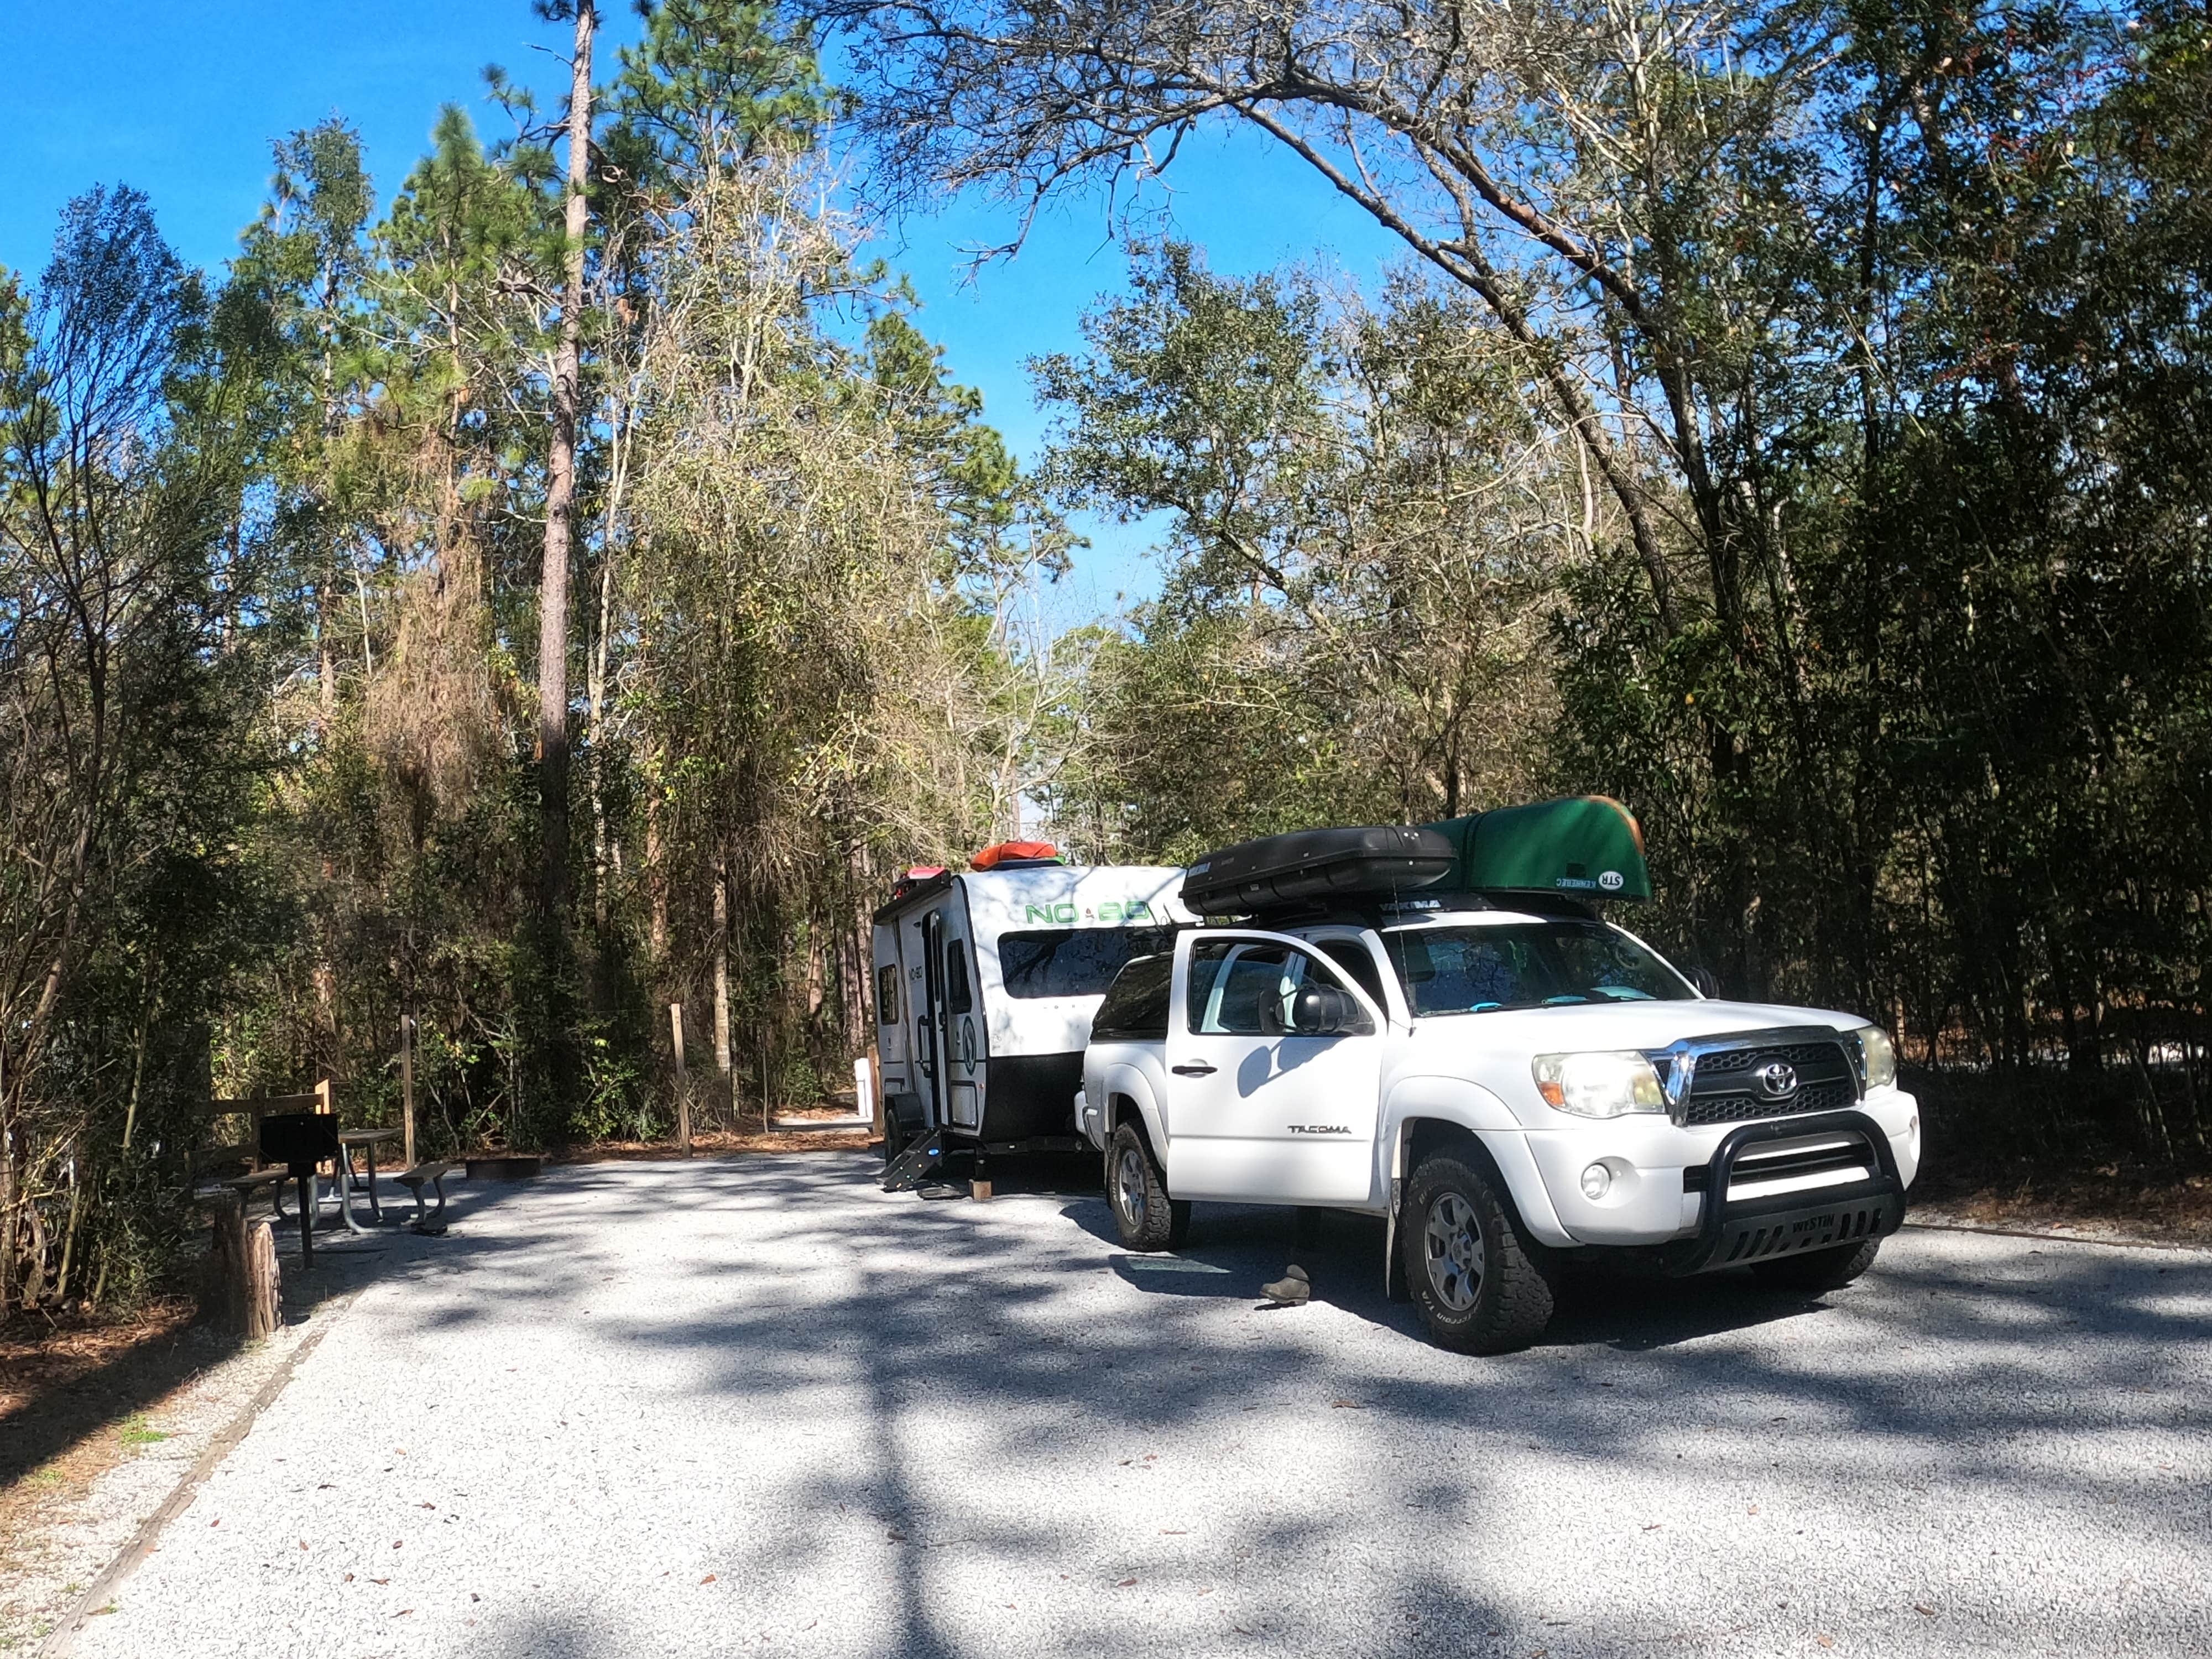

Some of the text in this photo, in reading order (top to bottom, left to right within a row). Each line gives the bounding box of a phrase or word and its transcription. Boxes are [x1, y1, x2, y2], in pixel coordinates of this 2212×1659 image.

[1602, 875, 1621, 886] STR
[1025, 901, 1150, 924] NO BO
[1287, 1125, 1352, 1134] TACOMA
[1792, 1213, 1835, 1233] WESTIN
